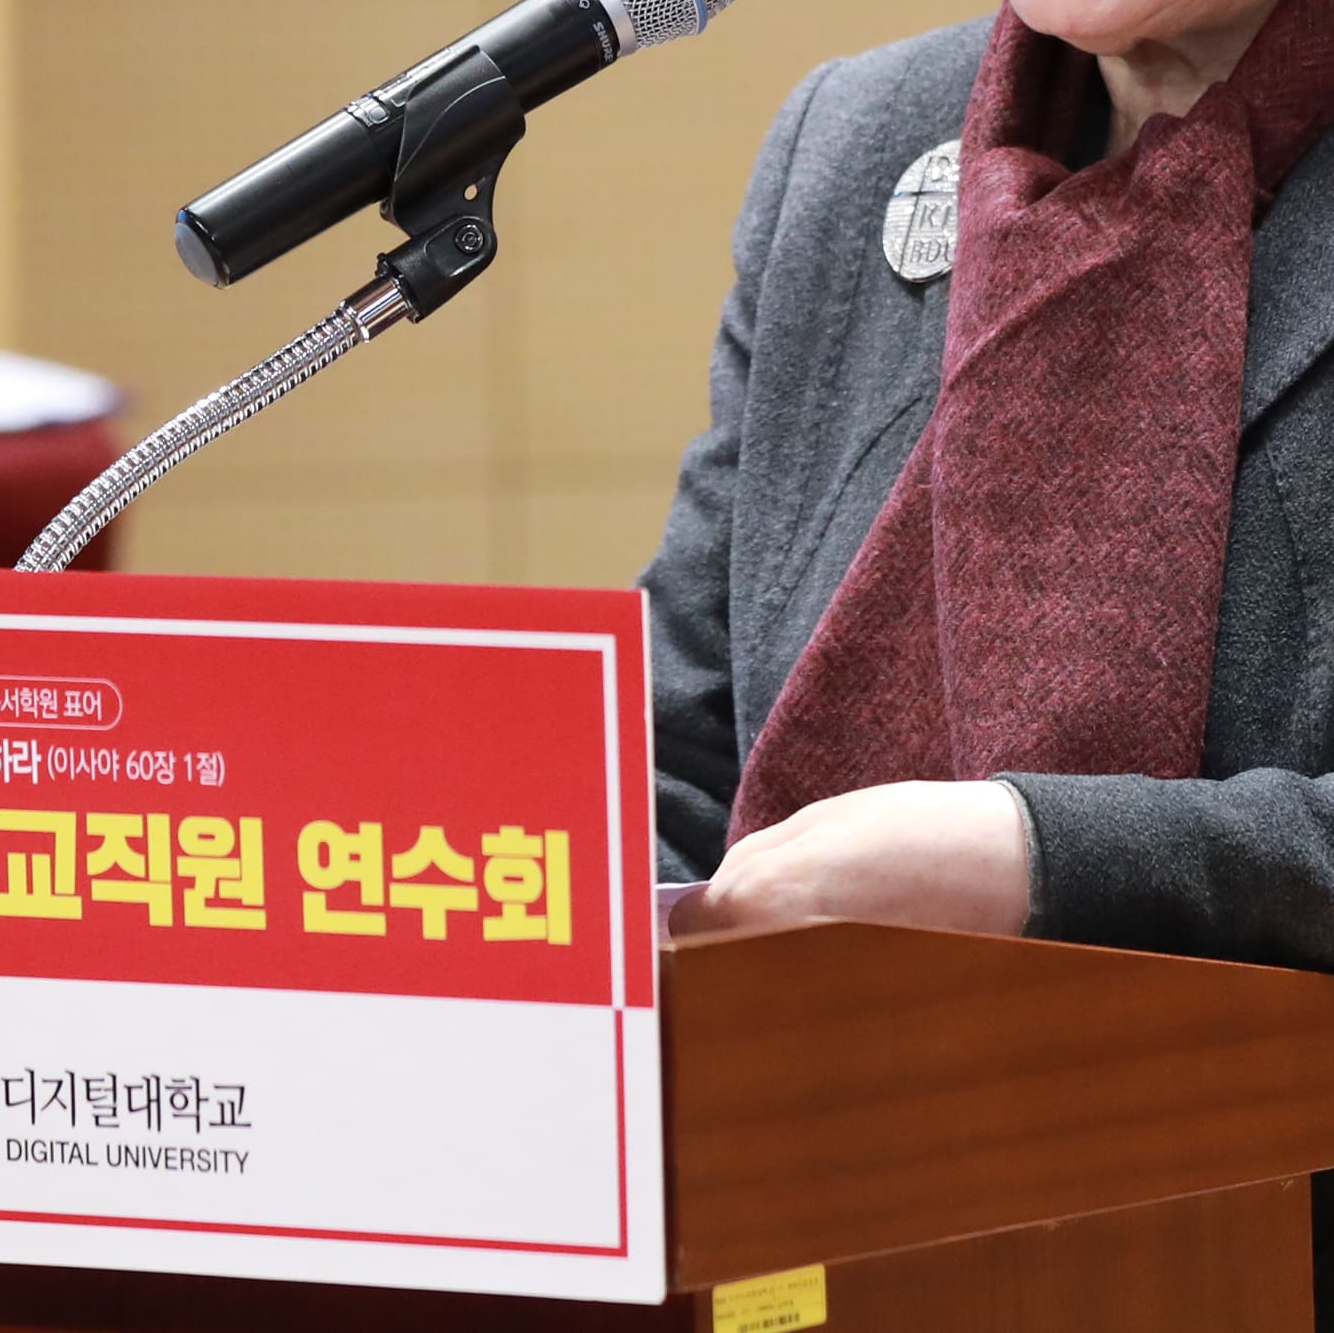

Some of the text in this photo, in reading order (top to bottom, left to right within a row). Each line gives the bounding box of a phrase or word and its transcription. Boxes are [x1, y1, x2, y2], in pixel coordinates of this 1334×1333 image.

[592, 21, 614, 63] SHURE
[63, 690, 103, 722] 표어
[47, 745, 120, 783] (이사야
[126, 749, 176, 786] 60장
[183, 750, 226, 788] 1절)
[297, 819, 573, 946] 연수회
[5, 1138, 99, 1166] DIGITAL
[106, 1144, 250, 1175] UNIVERSITY
